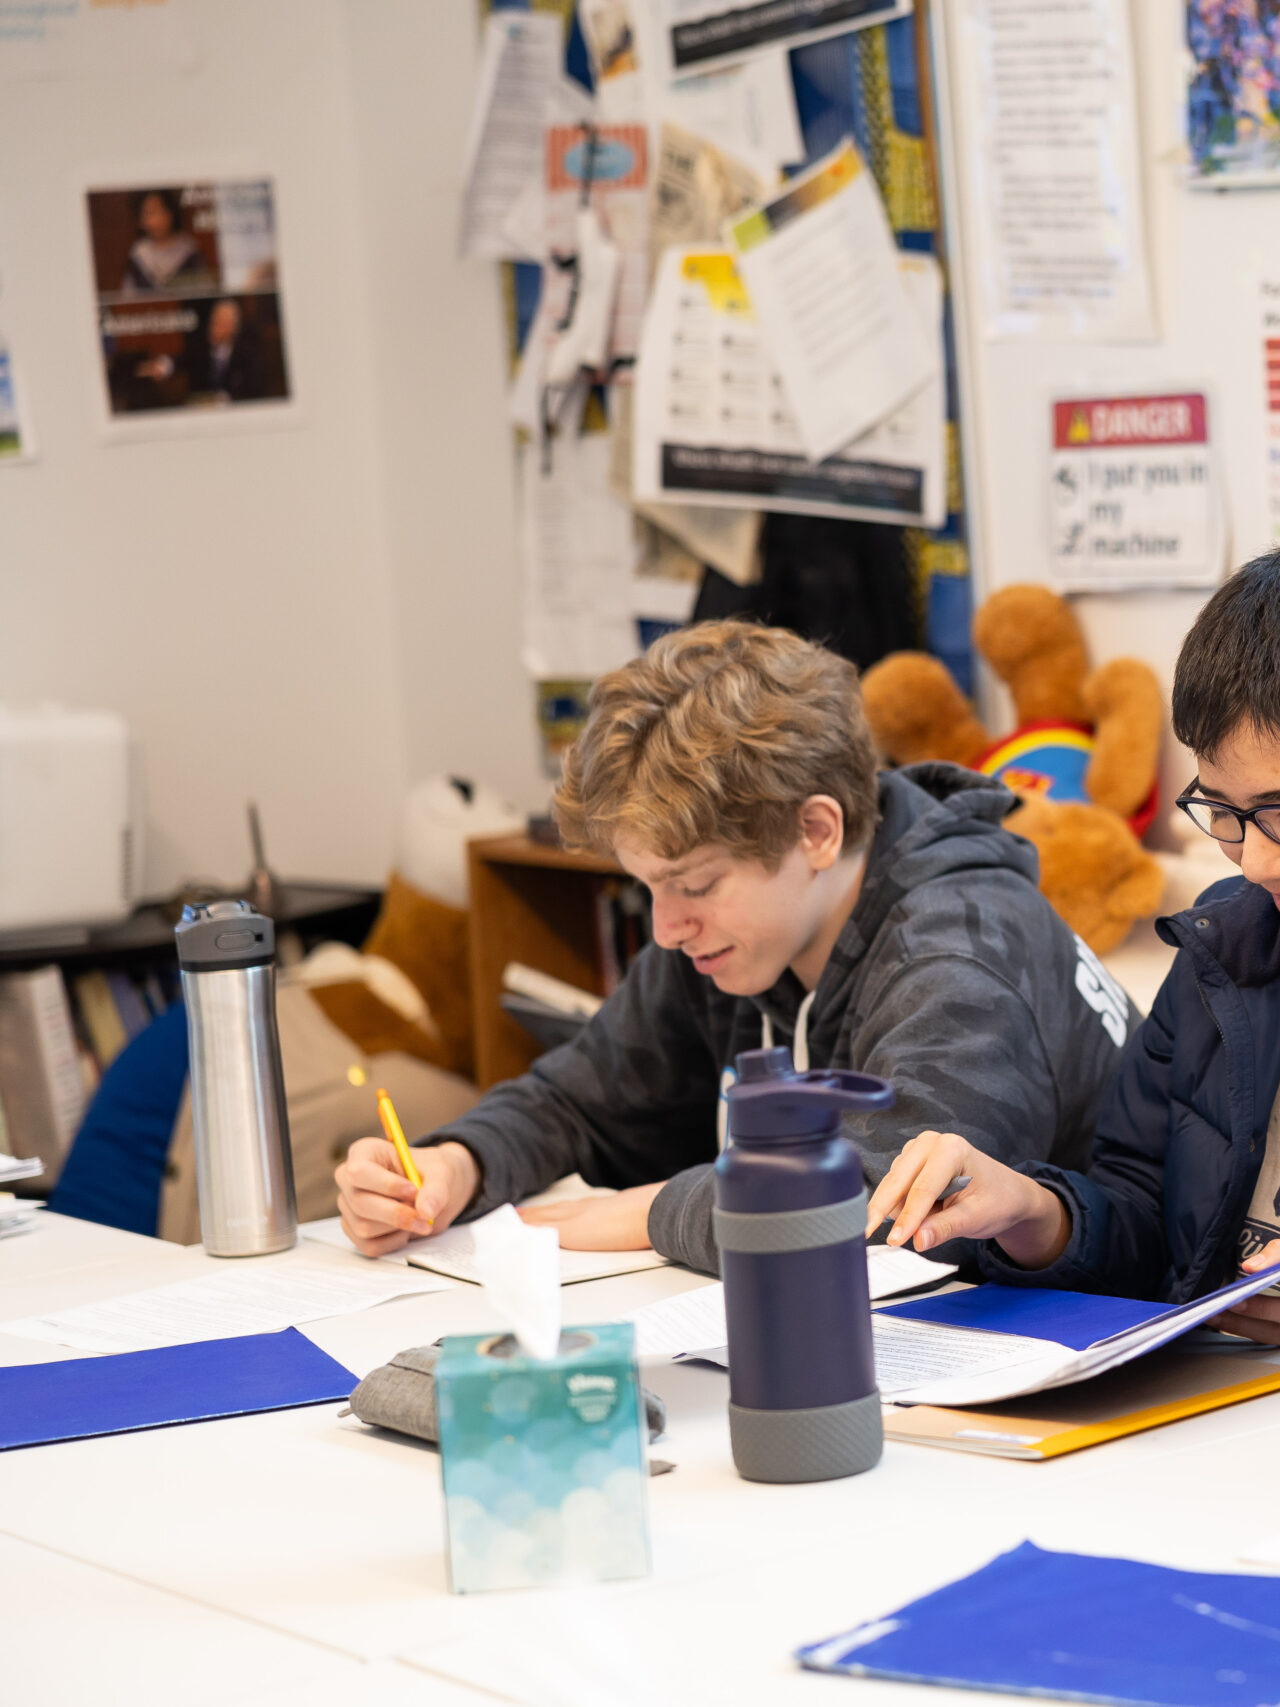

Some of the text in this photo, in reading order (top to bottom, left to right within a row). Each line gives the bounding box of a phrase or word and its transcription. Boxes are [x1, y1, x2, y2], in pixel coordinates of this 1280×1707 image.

[1092, 400, 1192, 442] DANGER
[1103, 460, 1138, 493] put
[1145, 463, 1182, 495] you
[1189, 458, 1208, 482] in
[1091, 501, 1124, 527] my
[1092, 531, 1179, 560] machine
